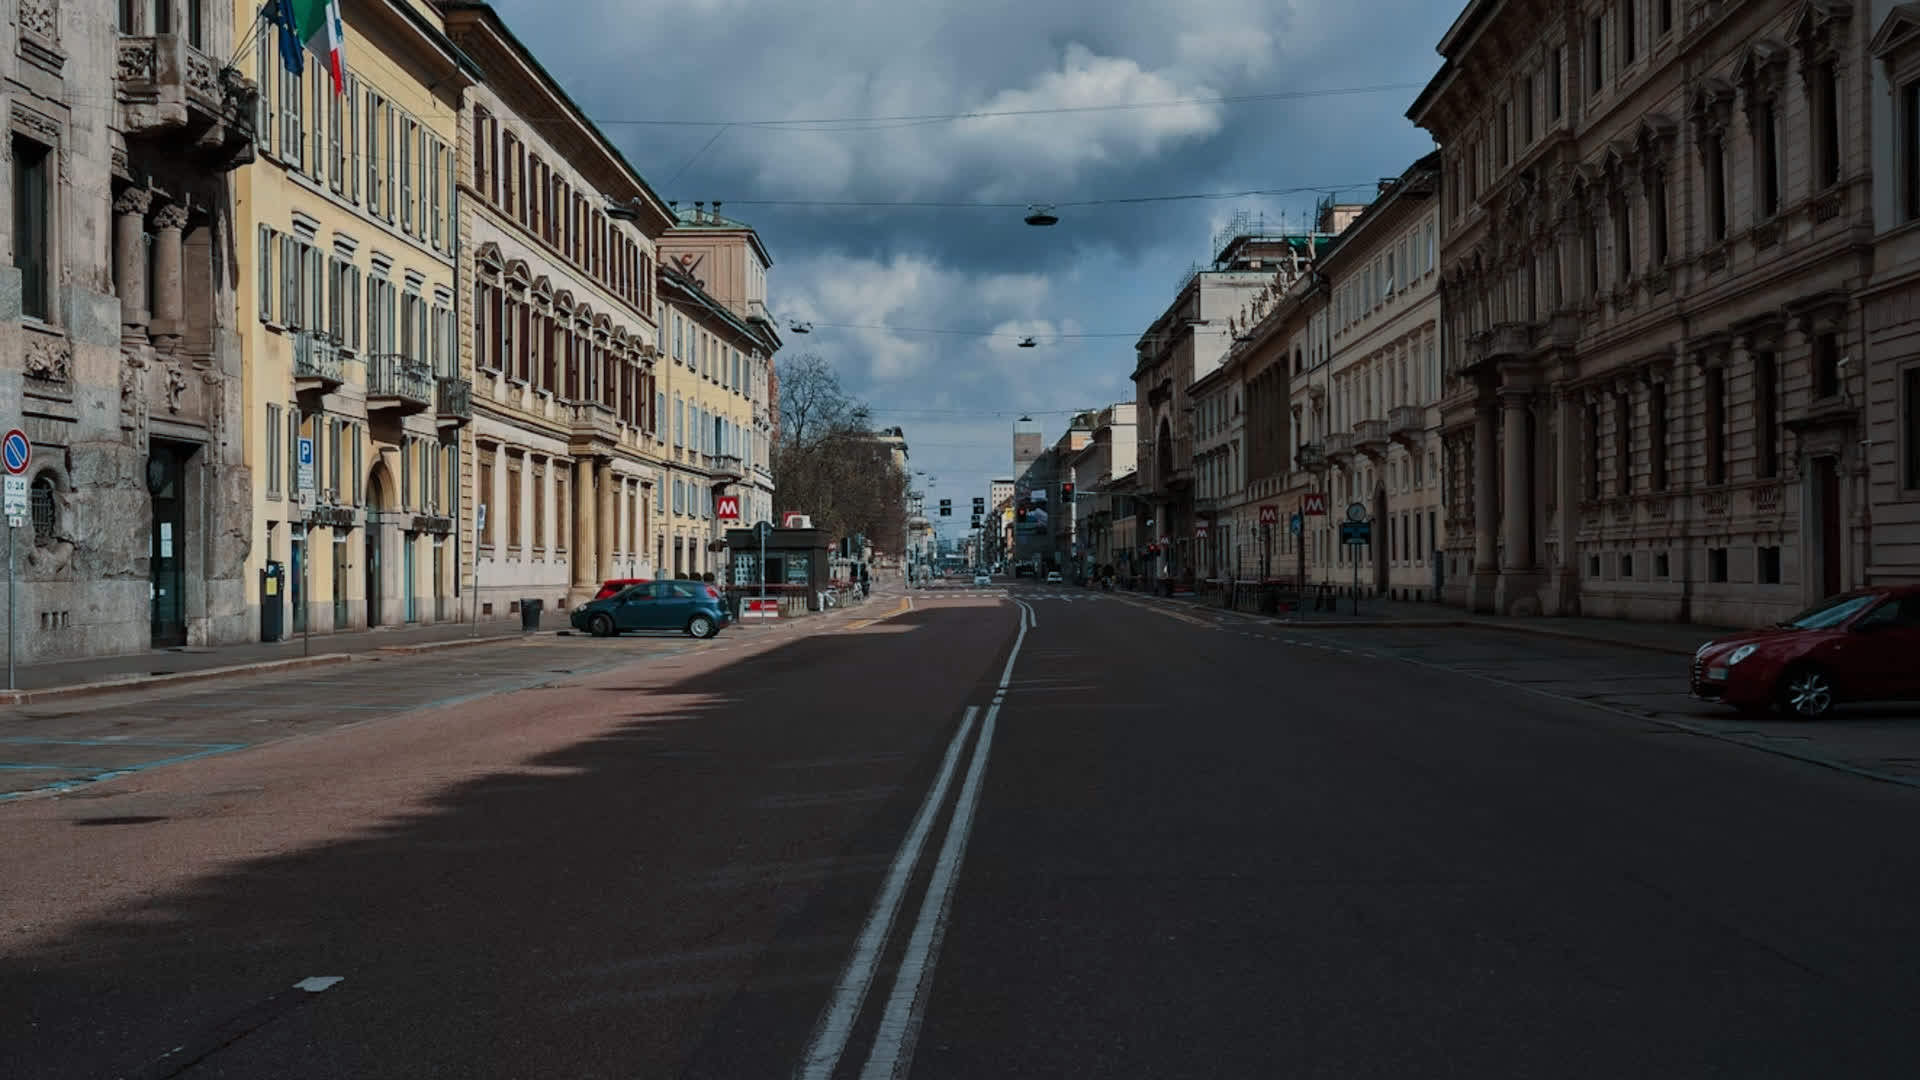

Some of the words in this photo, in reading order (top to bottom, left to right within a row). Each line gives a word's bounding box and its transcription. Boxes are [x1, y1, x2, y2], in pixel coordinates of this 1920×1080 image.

[302, 442, 310, 460] P
[719, 500, 738, 515] M
[1306, 497, 1325, 512] M
[1261, 508, 1276, 521] M
[1196, 528, 1207, 538] M
